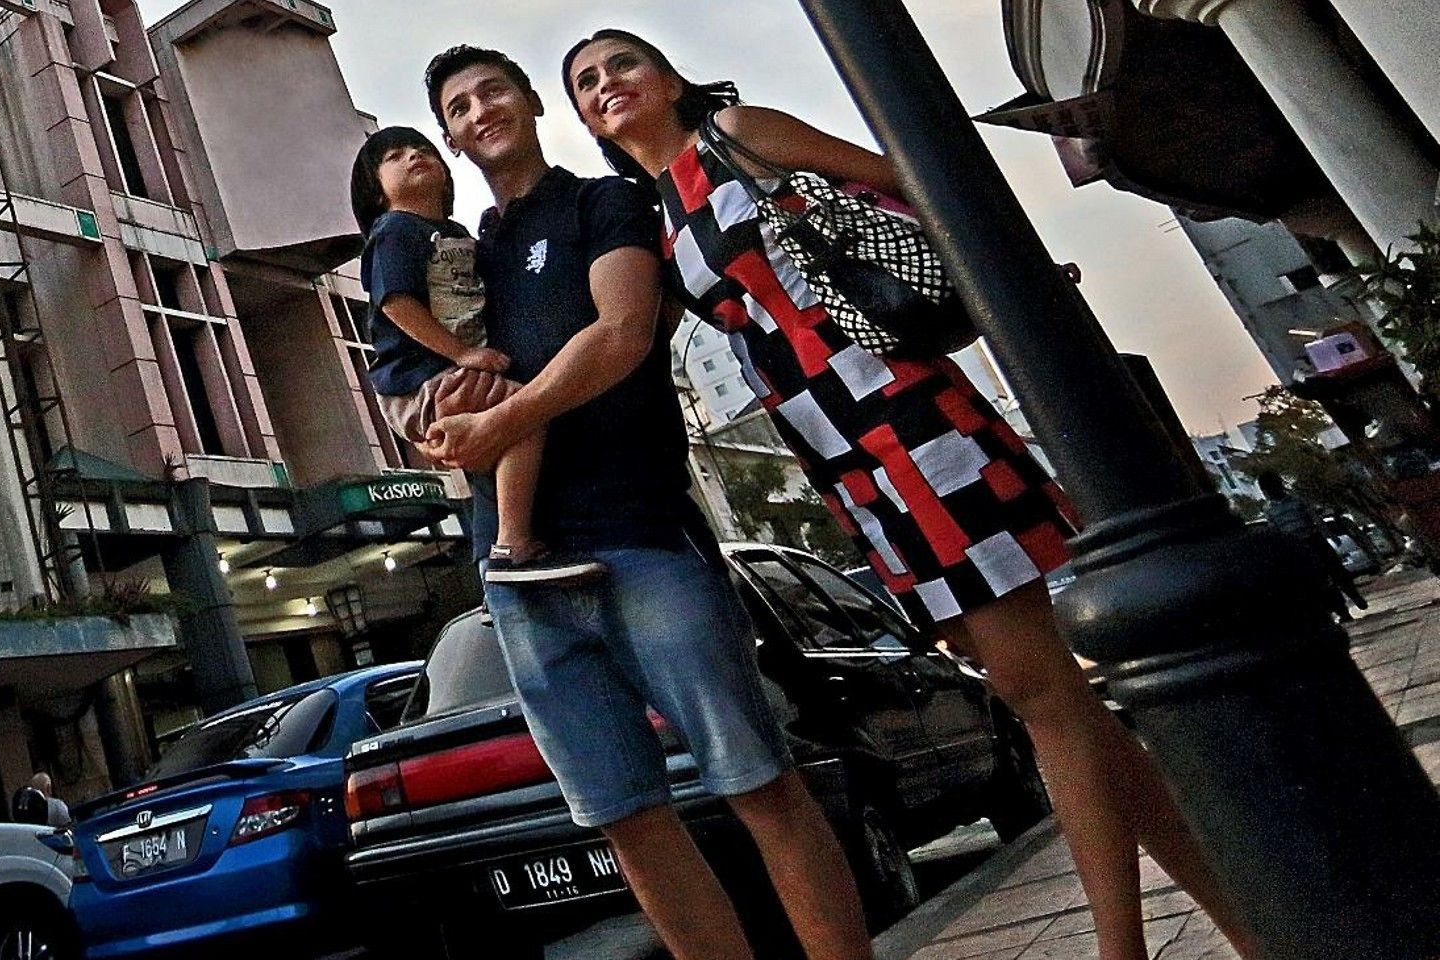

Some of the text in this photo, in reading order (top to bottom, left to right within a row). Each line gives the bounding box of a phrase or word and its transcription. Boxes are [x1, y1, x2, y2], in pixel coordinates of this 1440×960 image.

[493, 847, 618, 895] D 1849 NH
